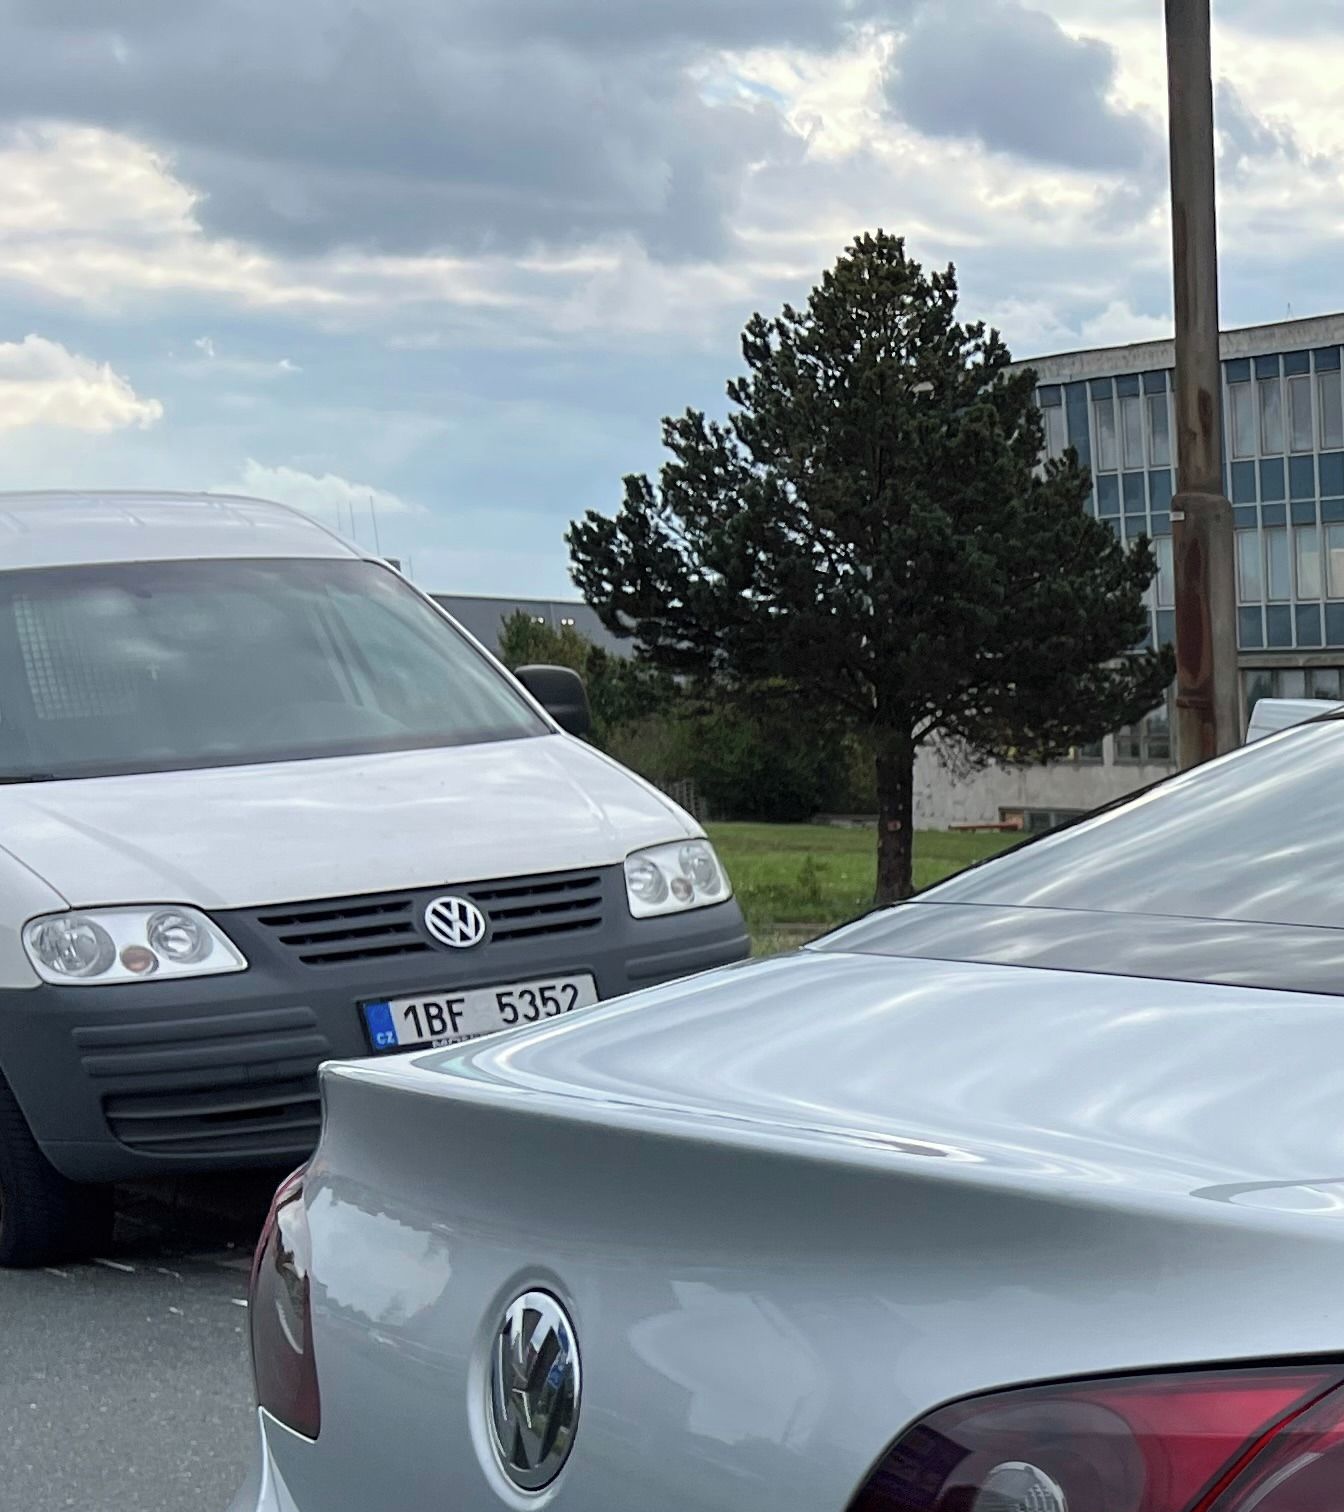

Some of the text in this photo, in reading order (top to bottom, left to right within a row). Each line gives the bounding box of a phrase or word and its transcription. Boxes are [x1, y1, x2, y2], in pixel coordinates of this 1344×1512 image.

[403, 984, 579, 1038] 1BF 5352
[376, 1031, 396, 1045] CZ
